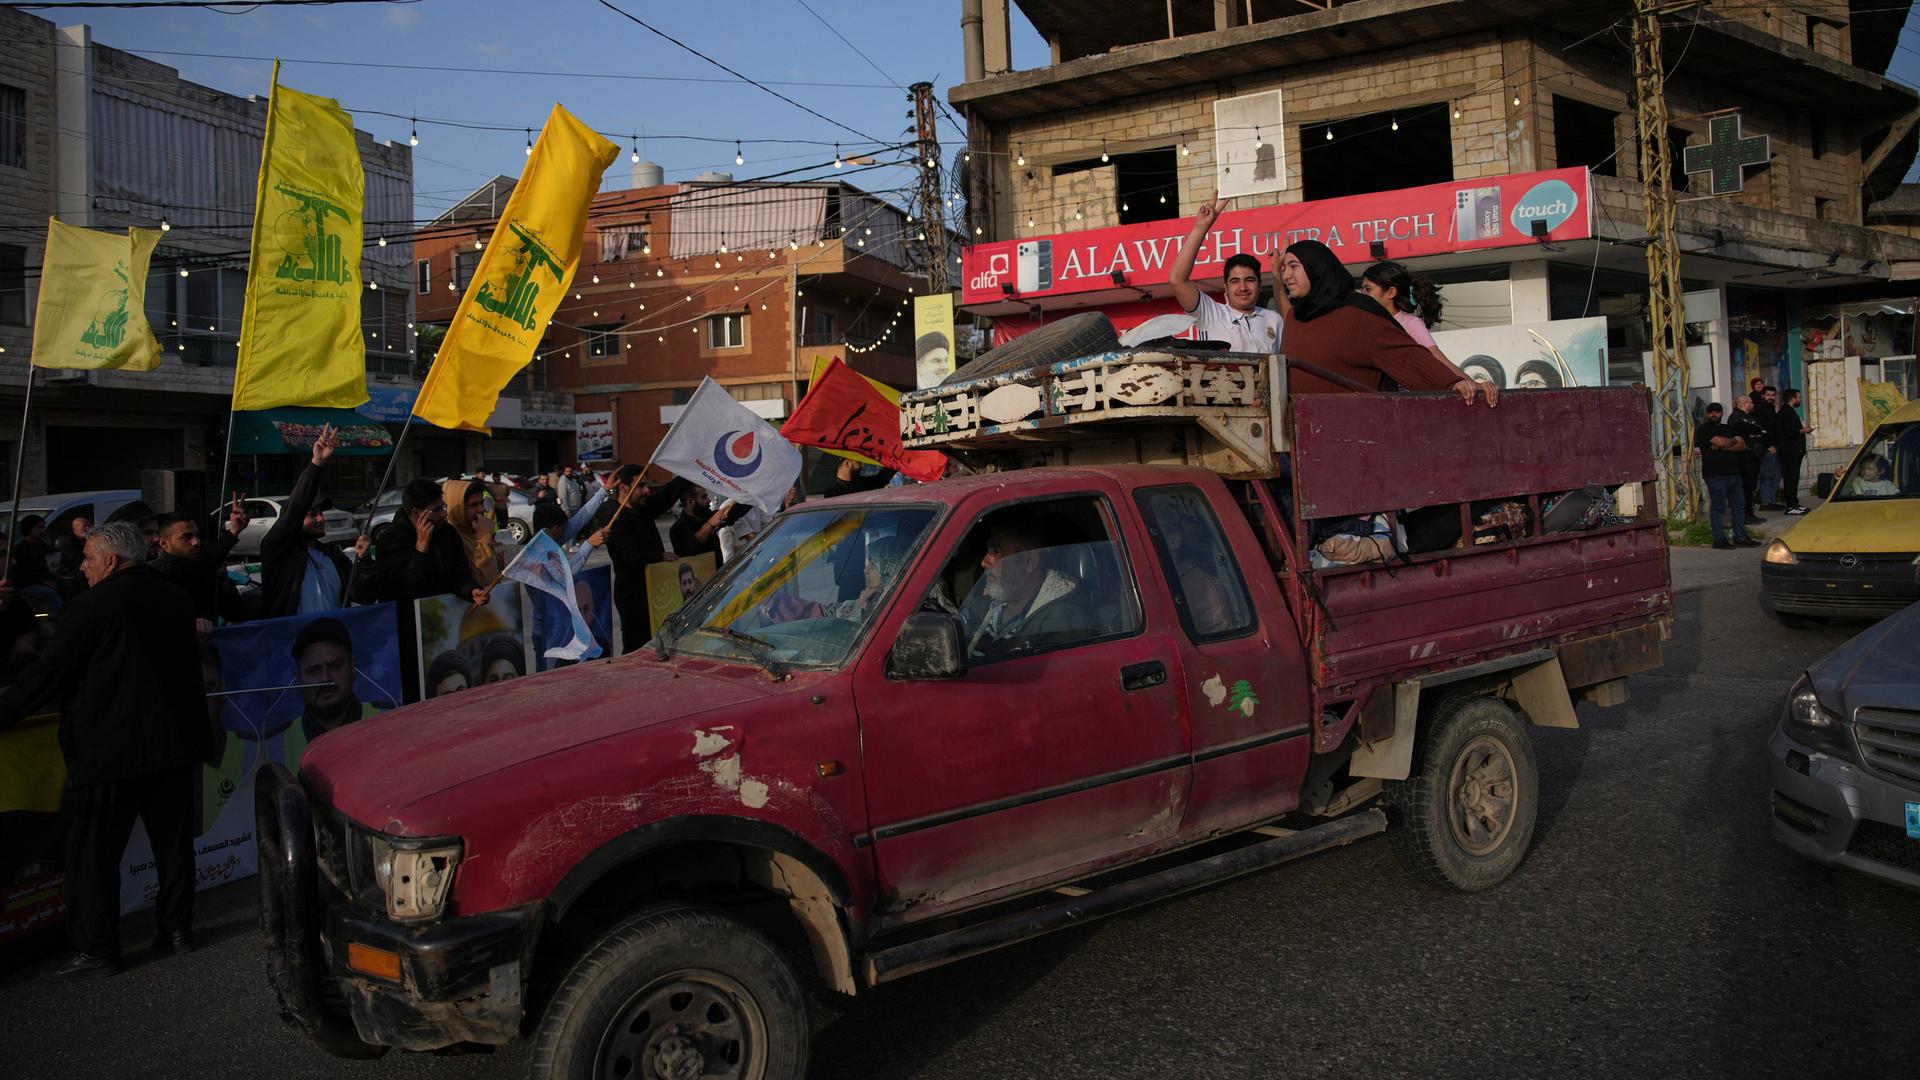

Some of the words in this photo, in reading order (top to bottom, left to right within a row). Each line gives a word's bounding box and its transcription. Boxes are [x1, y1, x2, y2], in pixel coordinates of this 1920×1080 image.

[1492, 205, 1500, 221] Ultra
[1518, 200, 1567, 218] touch
[1352, 213, 1436, 244] TECH
[1484, 210, 1492, 237] Galaxy
[970, 271, 999, 290] alfa
[229, 831, 252, 847] الشهيد
